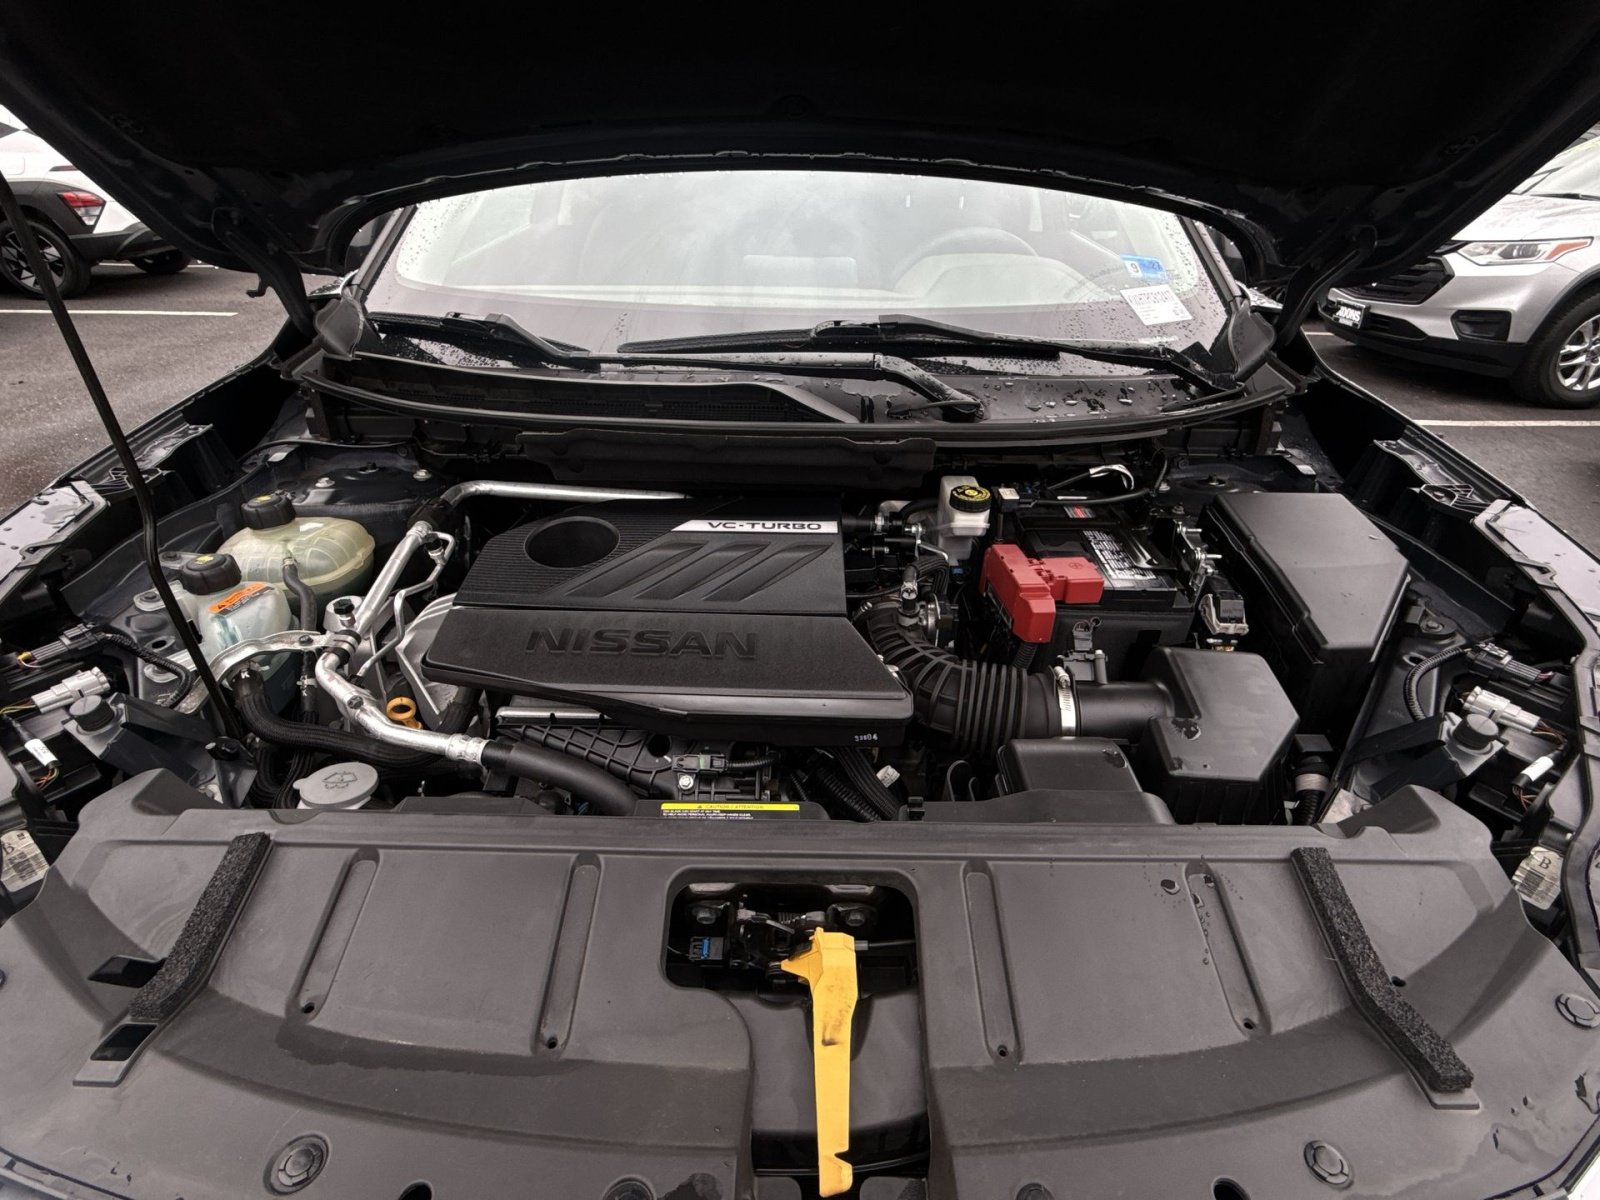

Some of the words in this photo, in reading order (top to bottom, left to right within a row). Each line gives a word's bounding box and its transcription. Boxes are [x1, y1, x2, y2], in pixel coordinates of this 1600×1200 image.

[707, 521, 822, 531] VC-TURBO
[525, 627, 756, 659] NISSAN
[1539, 856, 1551, 869] B
